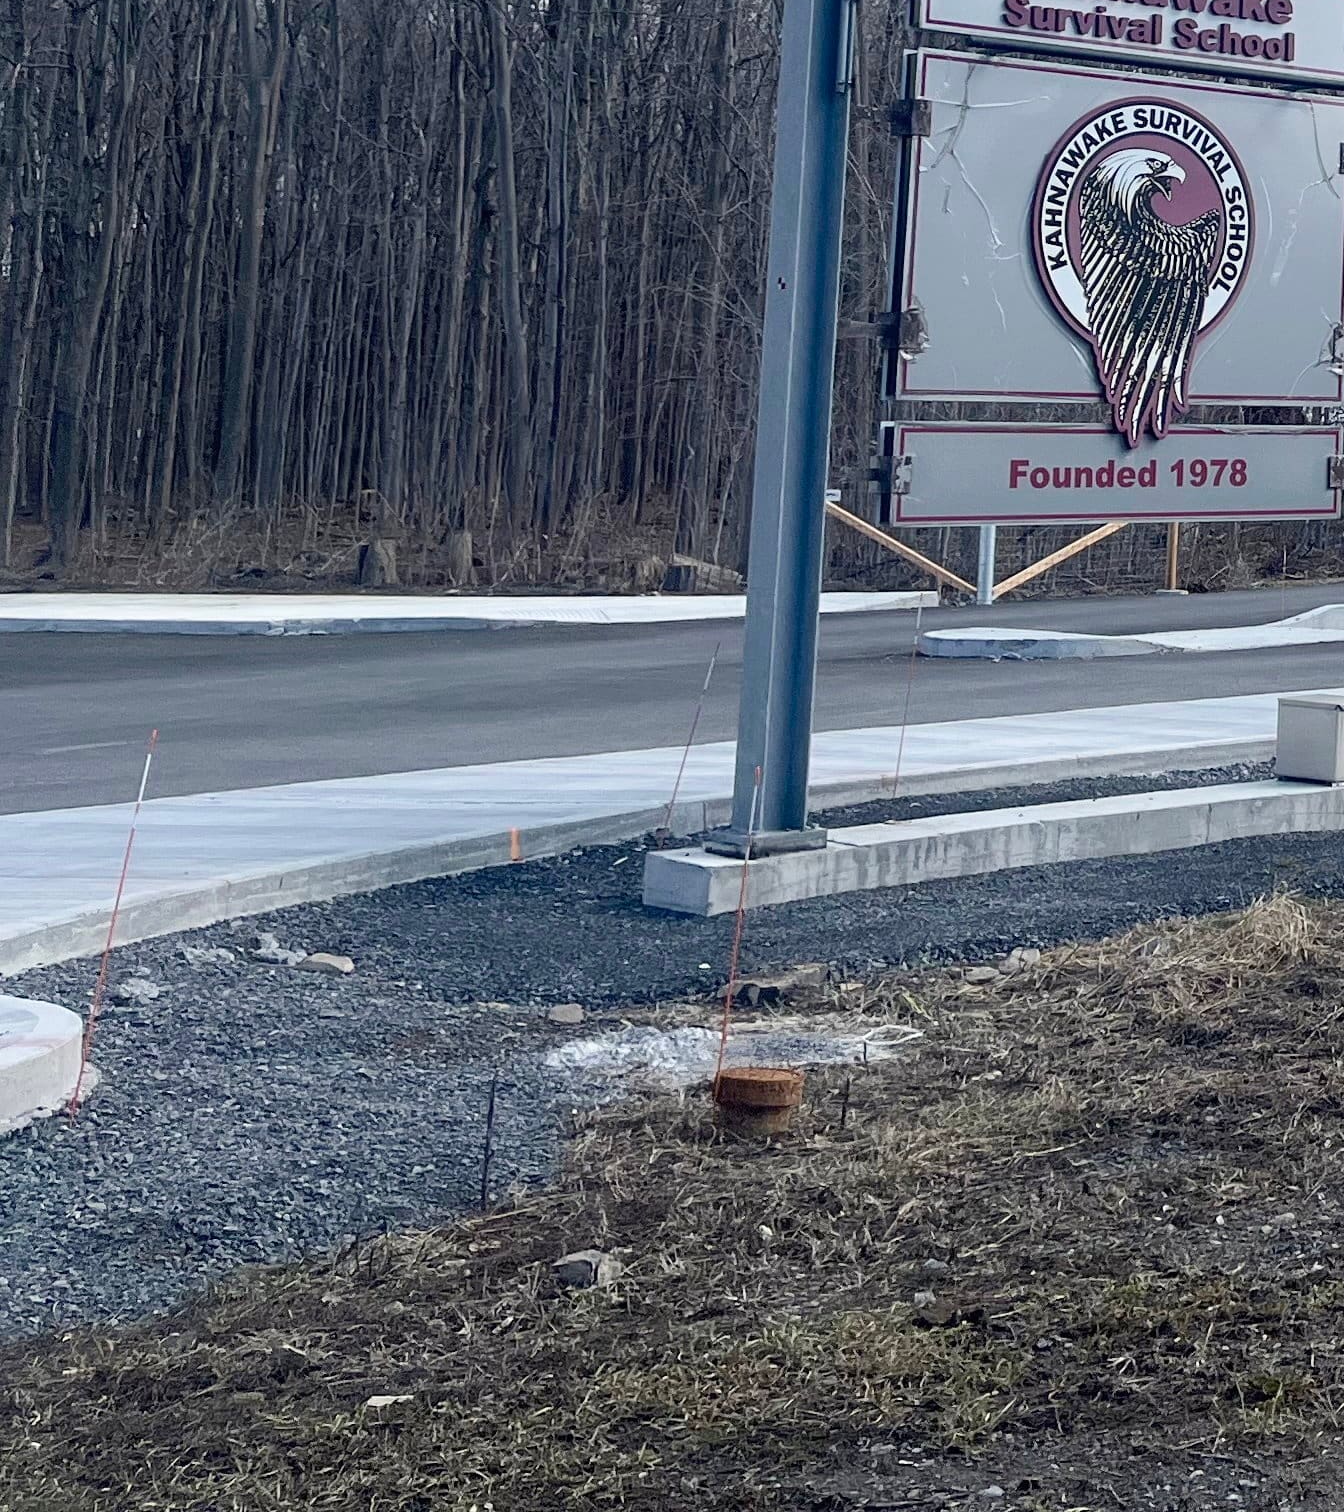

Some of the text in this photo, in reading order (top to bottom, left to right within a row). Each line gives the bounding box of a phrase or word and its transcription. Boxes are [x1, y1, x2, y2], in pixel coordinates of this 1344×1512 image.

[1174, 17, 1296, 62] School
[1044, 108, 1247, 293] KAHNAWAKE SURVIVAL SCHOOL
[1009, 458, 1248, 488] Founded 1978
